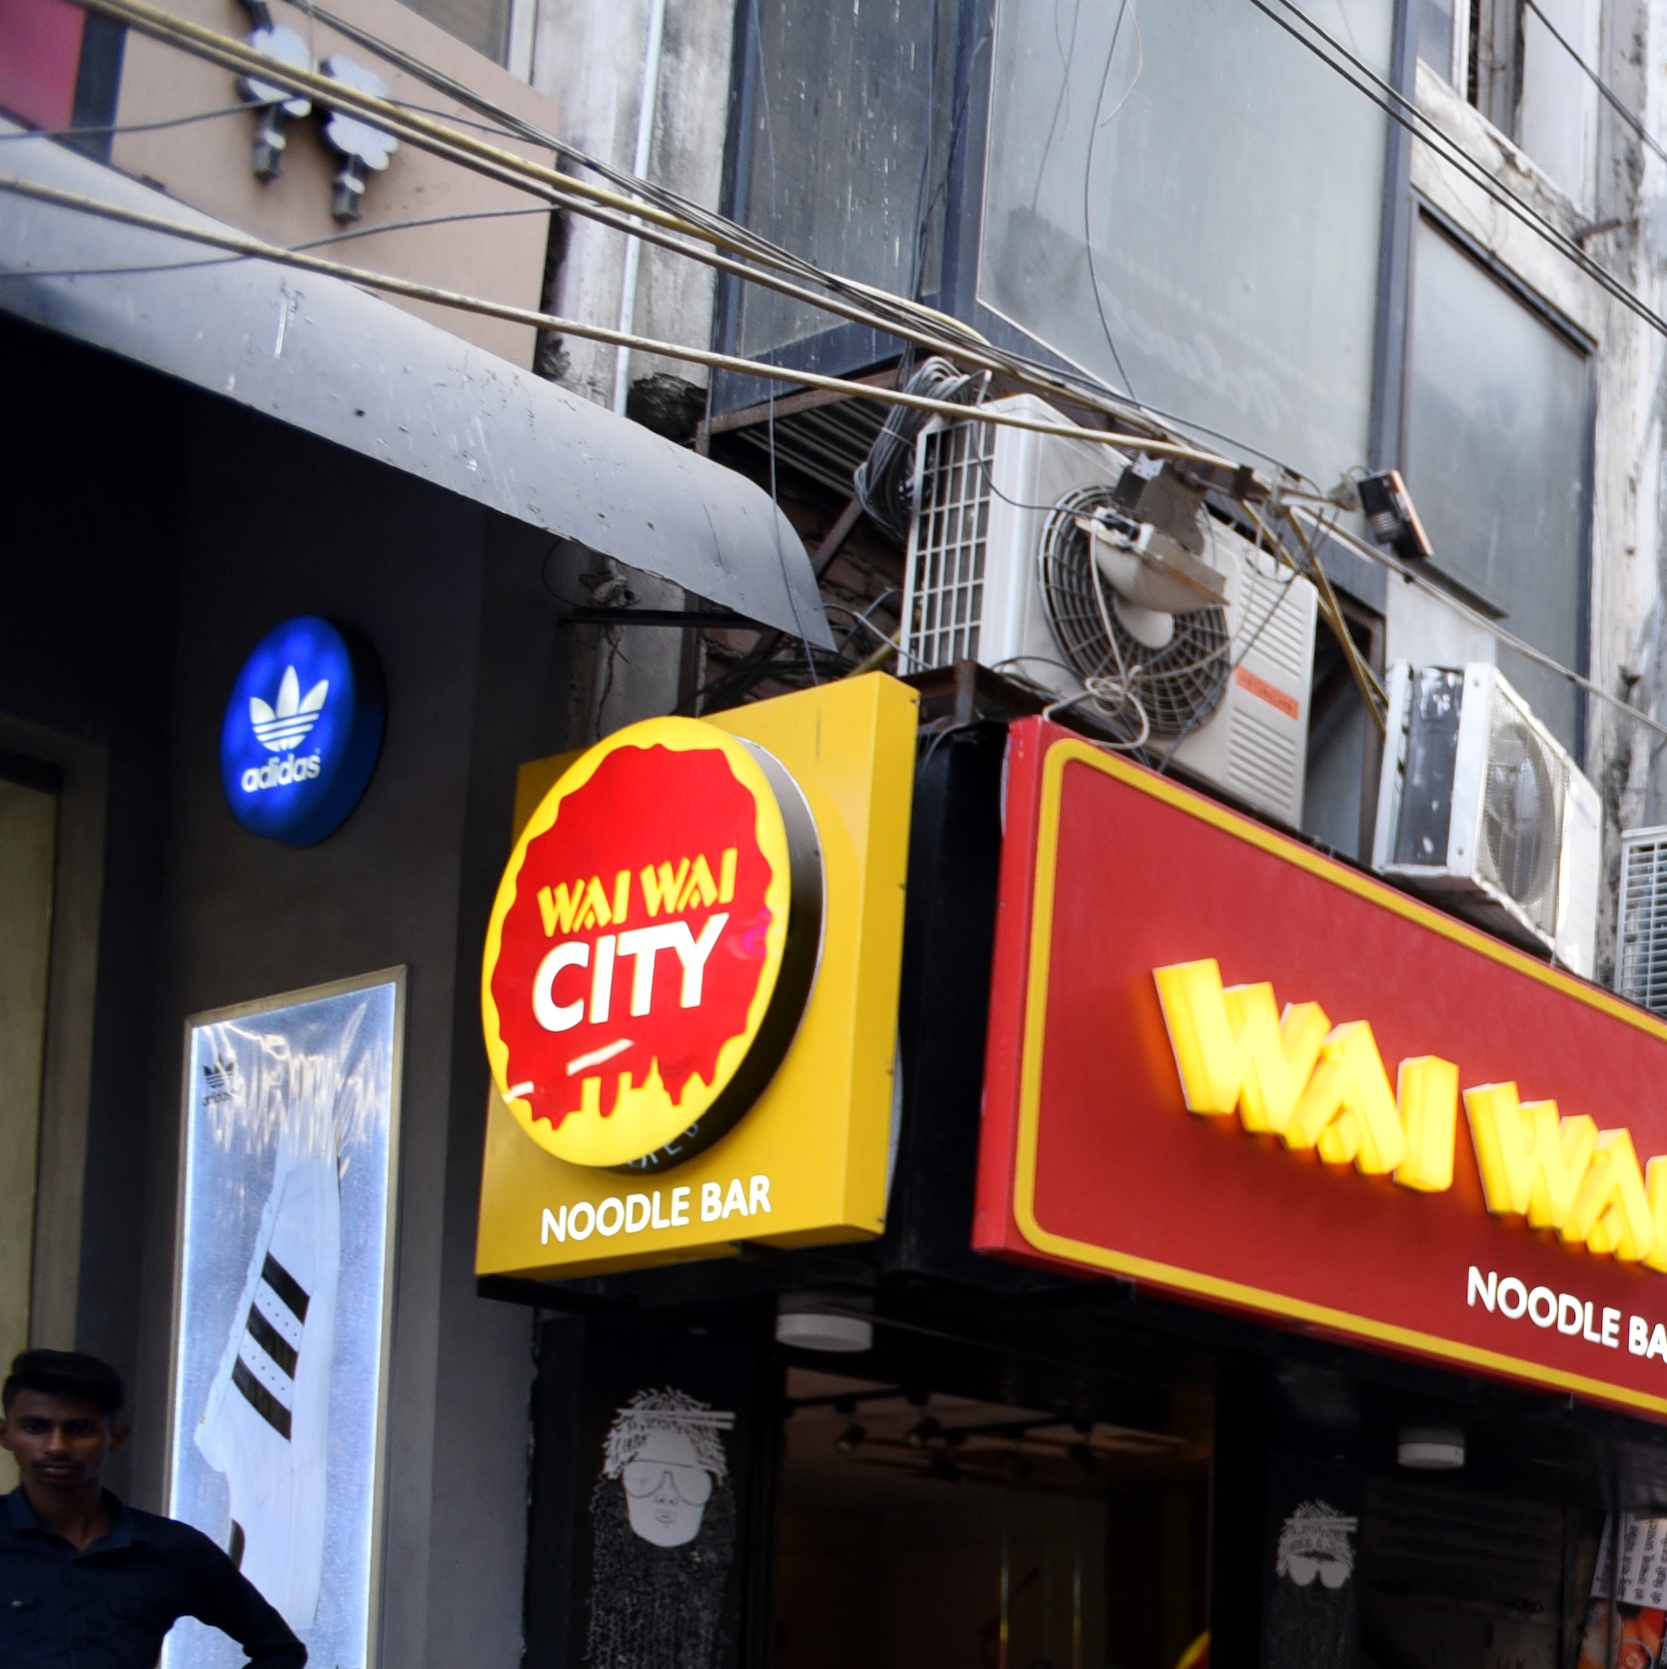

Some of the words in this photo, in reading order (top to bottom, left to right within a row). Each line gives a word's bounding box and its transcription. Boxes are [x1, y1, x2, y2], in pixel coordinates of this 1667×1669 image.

[241, 753, 322, 793] adidas
[537, 869, 632, 938] WAI
[639, 847, 738, 918] WAI
[531, 912, 731, 1033] CITY
[1153, 956, 1459, 1195] WAI
[540, 1185, 691, 1246] NOODLE
[699, 1173, 772, 1224] BAR
[1465, 1265, 1621, 1350] NOODLE
